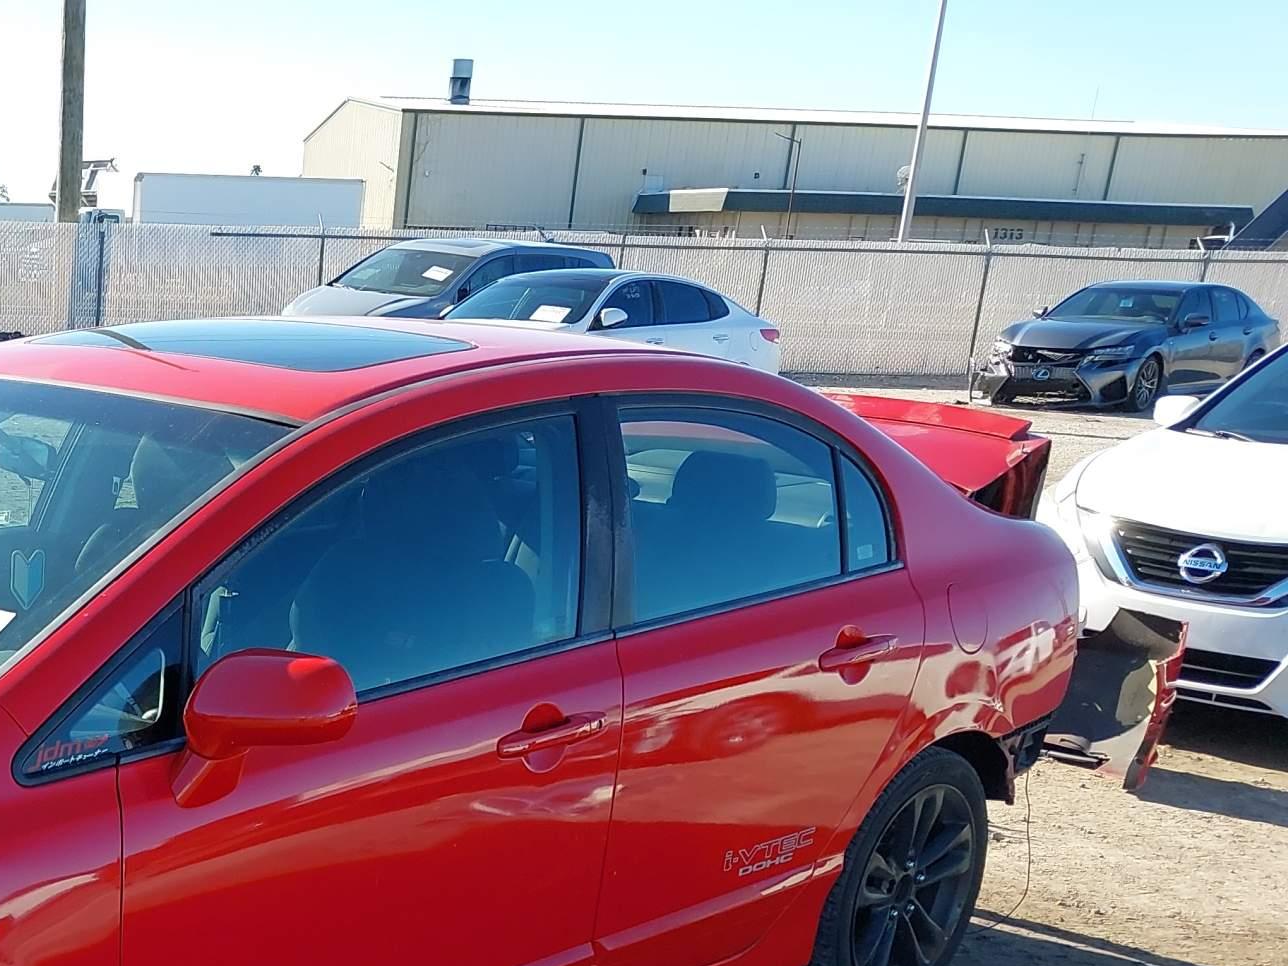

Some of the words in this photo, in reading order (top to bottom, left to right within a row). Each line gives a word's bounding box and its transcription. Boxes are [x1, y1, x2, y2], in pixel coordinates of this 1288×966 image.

[993, 227, 1024, 240] 1313
[1183, 559, 1222, 570] NISSAN
[738, 852, 794, 876] DOHC
